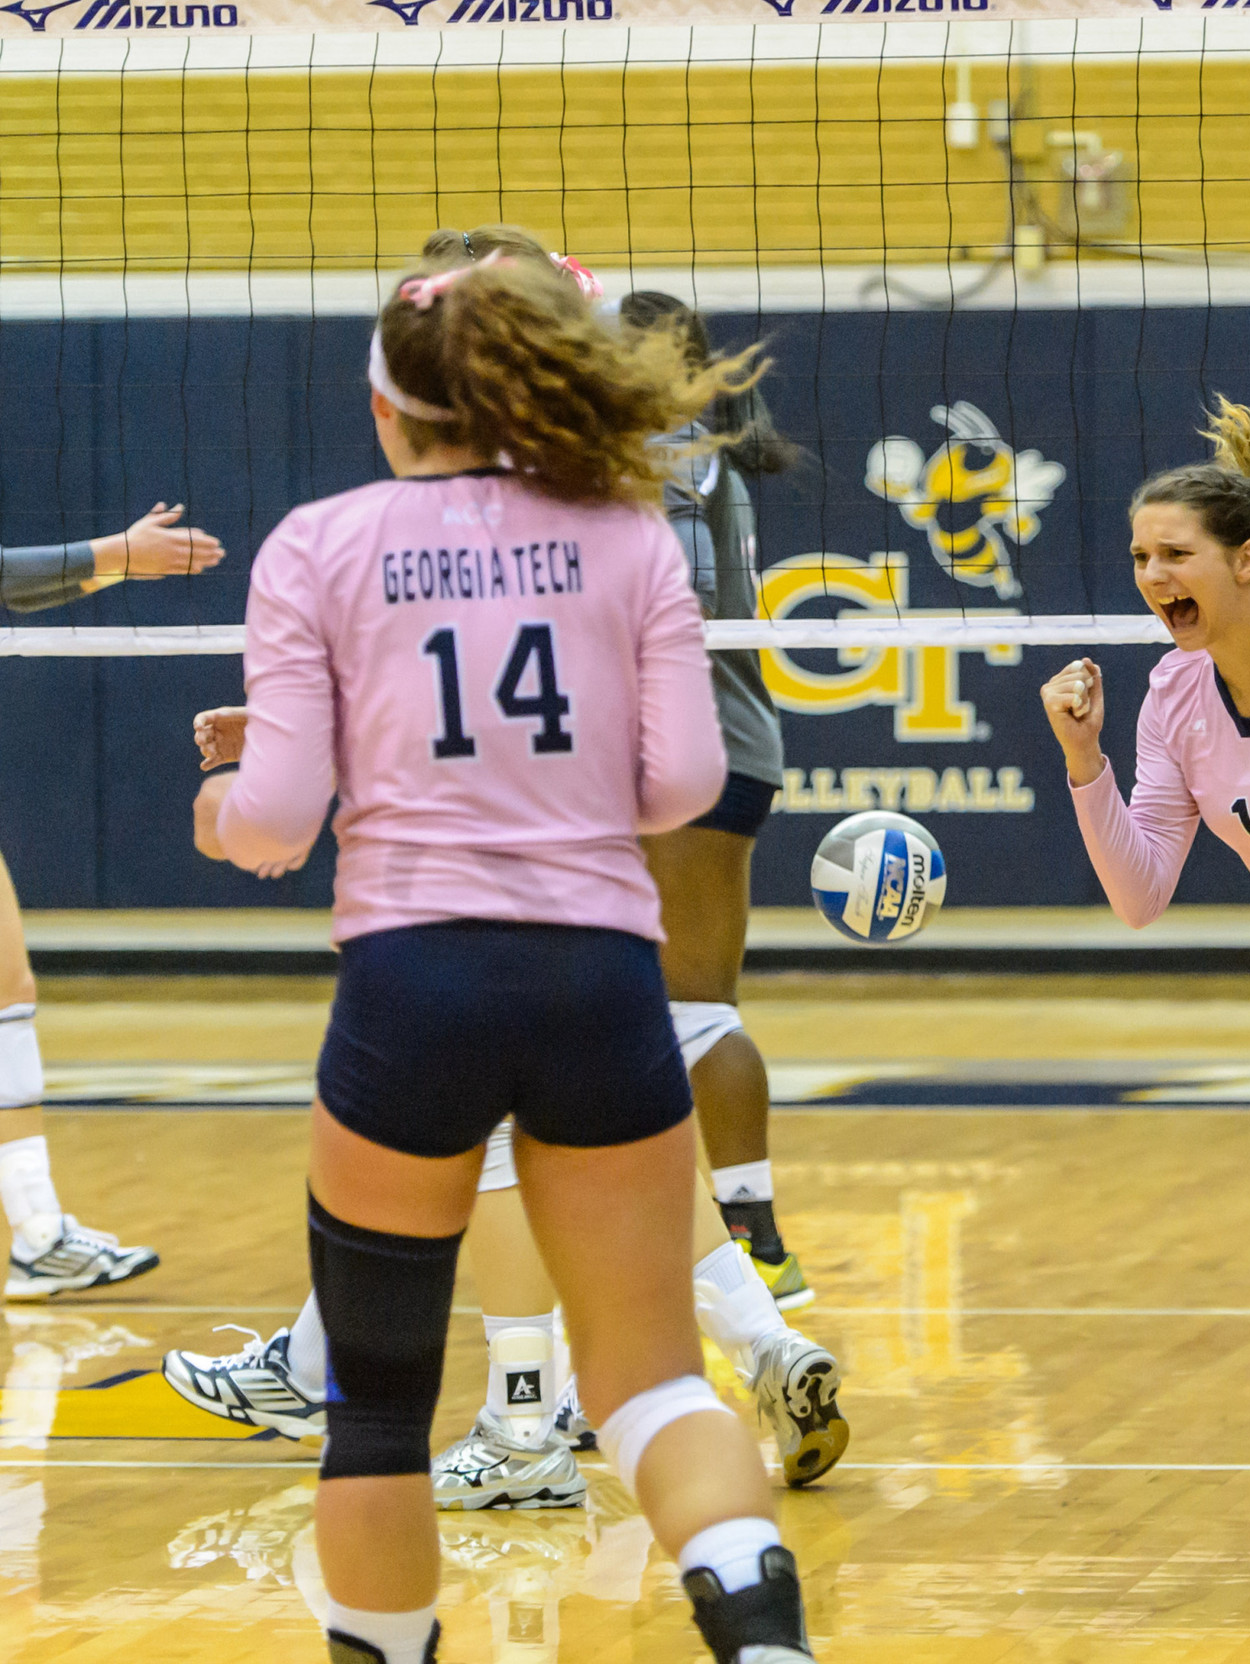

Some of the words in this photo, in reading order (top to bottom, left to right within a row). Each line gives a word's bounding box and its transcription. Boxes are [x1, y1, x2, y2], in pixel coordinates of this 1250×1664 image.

[74, 0, 238, 29] MIZUNO
[446, 0, 613, 23] MIZUNO
[382, 547, 507, 604] GEORGIA
[511, 540, 583, 596] TECH
[421, 620, 575, 762] 14
[769, 766, 1035, 814] LLEYBALL
[876, 852, 906, 921] NCAA
[901, 854, 925, 926] molten
